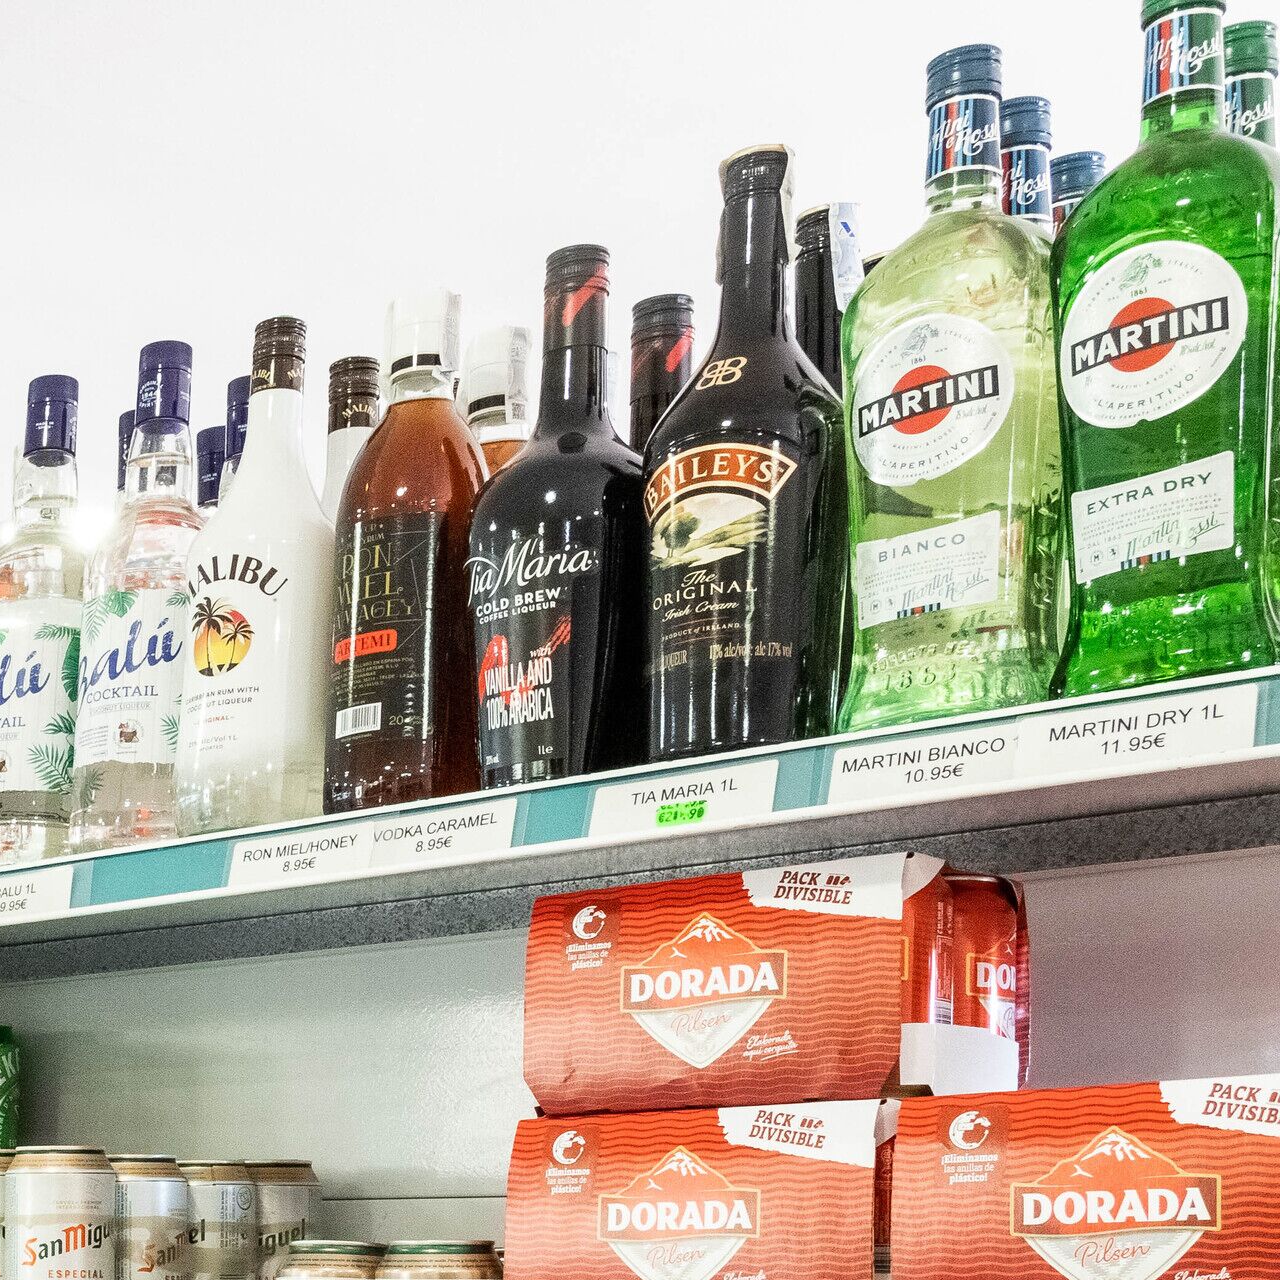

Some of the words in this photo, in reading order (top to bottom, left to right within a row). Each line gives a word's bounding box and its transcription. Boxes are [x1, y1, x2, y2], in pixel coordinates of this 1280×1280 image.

[1075, 302, 1222, 371] MARTINI
[862, 370, 992, 432] MARTINI
[646, 452, 776, 511] BAILEYS
[1088, 486, 1153, 514] EXTRA
[1164, 472, 1211, 492] DRY
[879, 533, 966, 562] BIANCO
[463, 557, 500, 607] Tia
[492, 539, 592, 599] Maria
[476, 598, 509, 617] COLD
[514, 587, 561, 606] BREW
[653, 579, 757, 610] ORIGINAL
[479, 611, 508, 625] COFFEE
[511, 601, 556, 616] LIQUEUR
[662, 608, 692, 622] Irish
[695, 600, 739, 614] Cream
[237, 686, 260, 695] WITH
[484, 661, 524, 696] VANILLA
[527, 657, 552, 687] AND
[486, 697, 508, 730] 100%
[509, 689, 554, 725] ARABICA
[1050, 716, 1138, 741] MARTINI
[1147, 708, 1192, 728] DRY
[1202, 704, 1223, 719] 1L
[842, 750, 921, 773] MARTINI
[928, 738, 1005, 761] BIANCO
[1102, 733, 1166, 754] 11.95€
[906, 763, 964, 783] 10.95€
[632, 791, 656, 805] TIA
[661, 782, 714, 800] MARIA
[721, 778, 737, 791] 1L
[374, 825, 422, 842] VODKA
[427, 813, 496, 834] CARAMEL
[243, 846, 272, 862] RON
[276, 835, 357, 857] MIEL/HONEY
[415, 836, 452, 852] 8.95€
[283, 857, 316, 872] 8.95€
[780, 871, 821, 885] PACK
[774, 885, 852, 904] DIVISIBLE
[631, 962, 778, 1005] DORADA
[1209, 1083, 1261, 1102] PACK
[755, 1110, 795, 1127] PACK
[749, 1125, 825, 1148] DIVISIBLE
[608, 1200, 752, 1231] DORADA
[1022, 1188, 1210, 1225] DORADA
[1074, 1239, 1150, 1267] Pilsen
[48, 1269, 104, 1280] ESPECIAL
